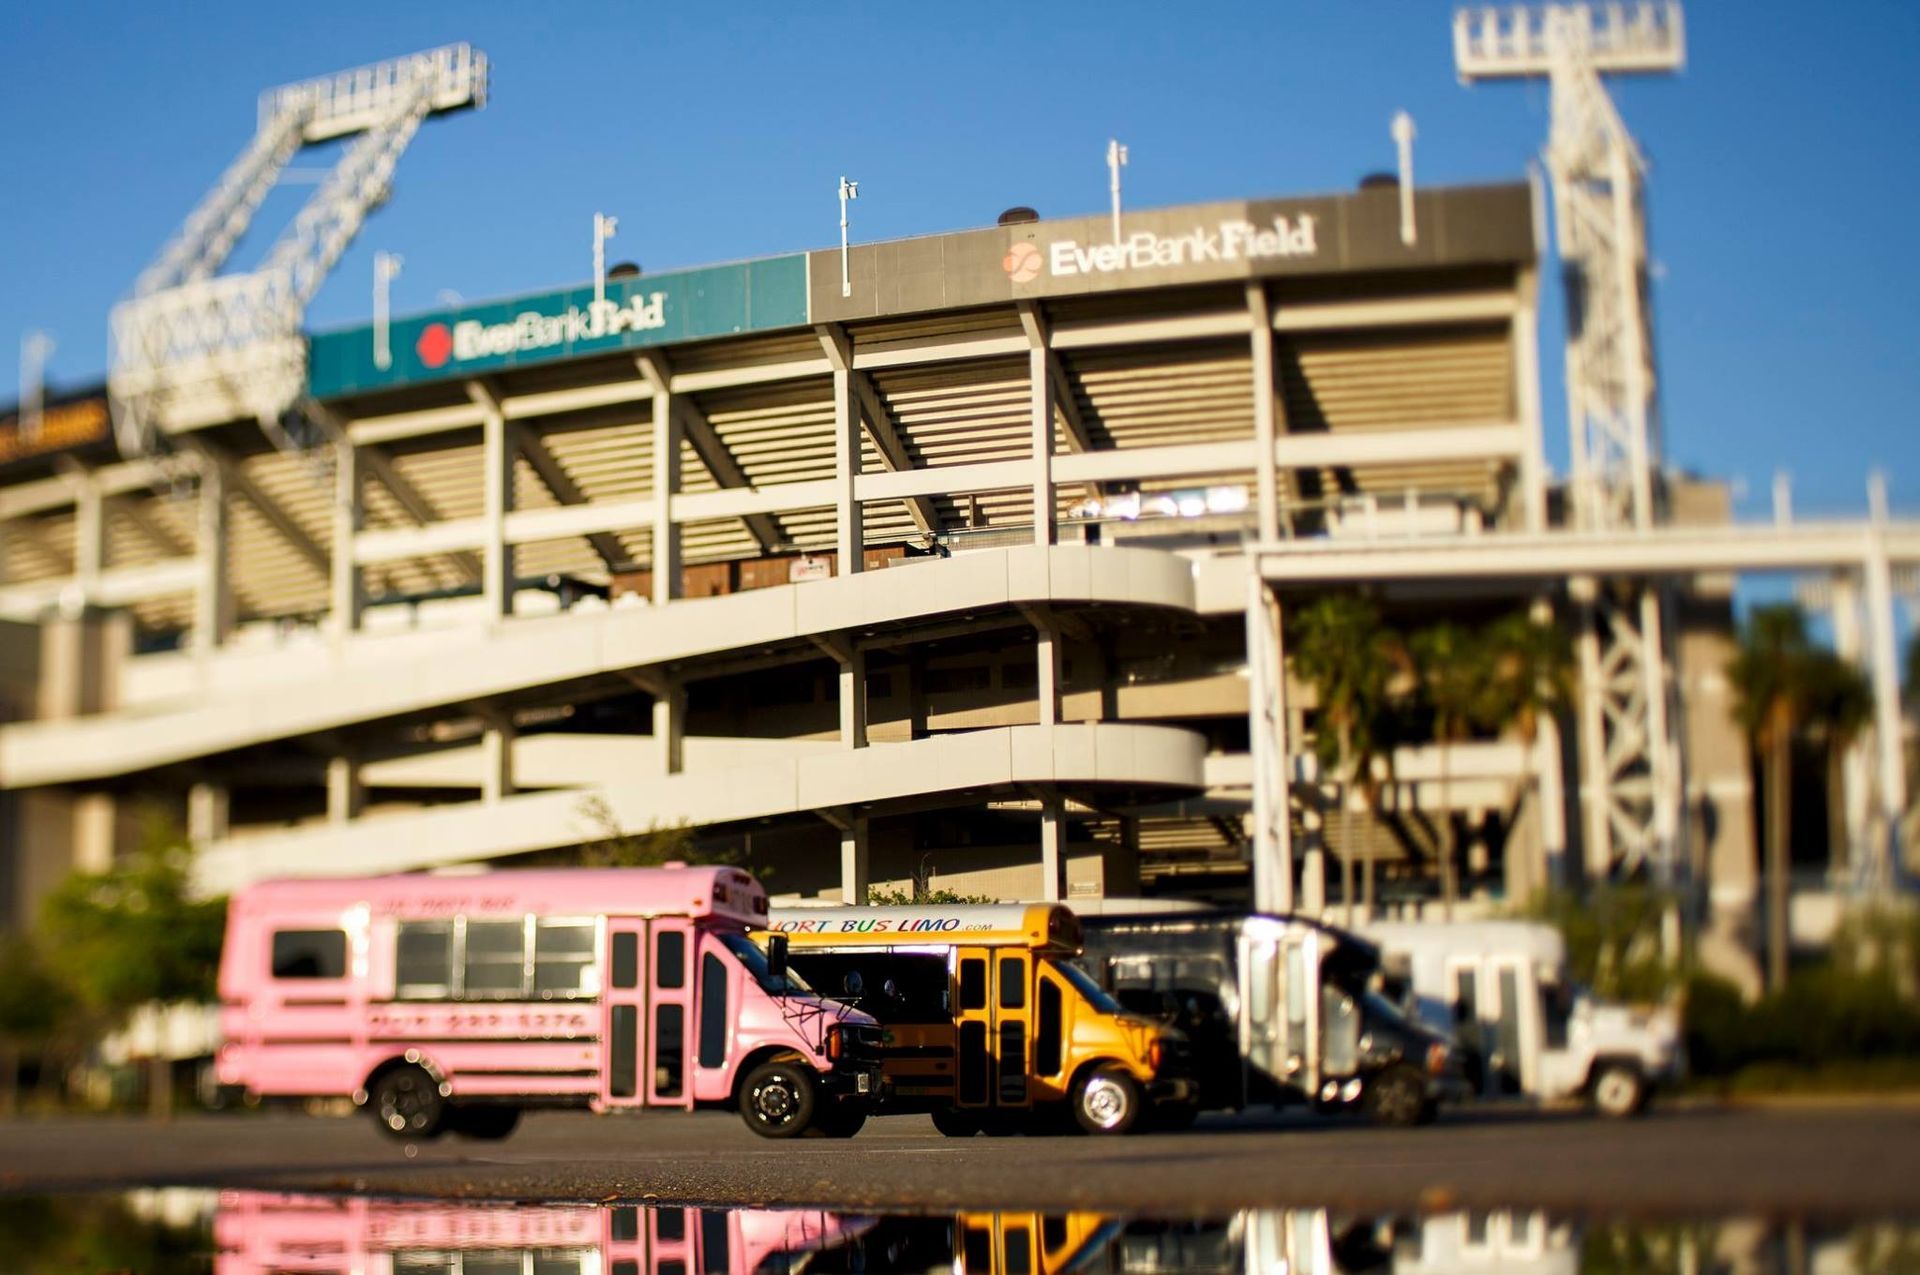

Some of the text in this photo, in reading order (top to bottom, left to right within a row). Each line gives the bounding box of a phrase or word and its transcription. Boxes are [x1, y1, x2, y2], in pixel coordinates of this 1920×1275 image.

[1049, 213, 1317, 277] EverBank Field
[841, 918, 892, 932] BUS
[898, 918, 960, 932] LIMO
